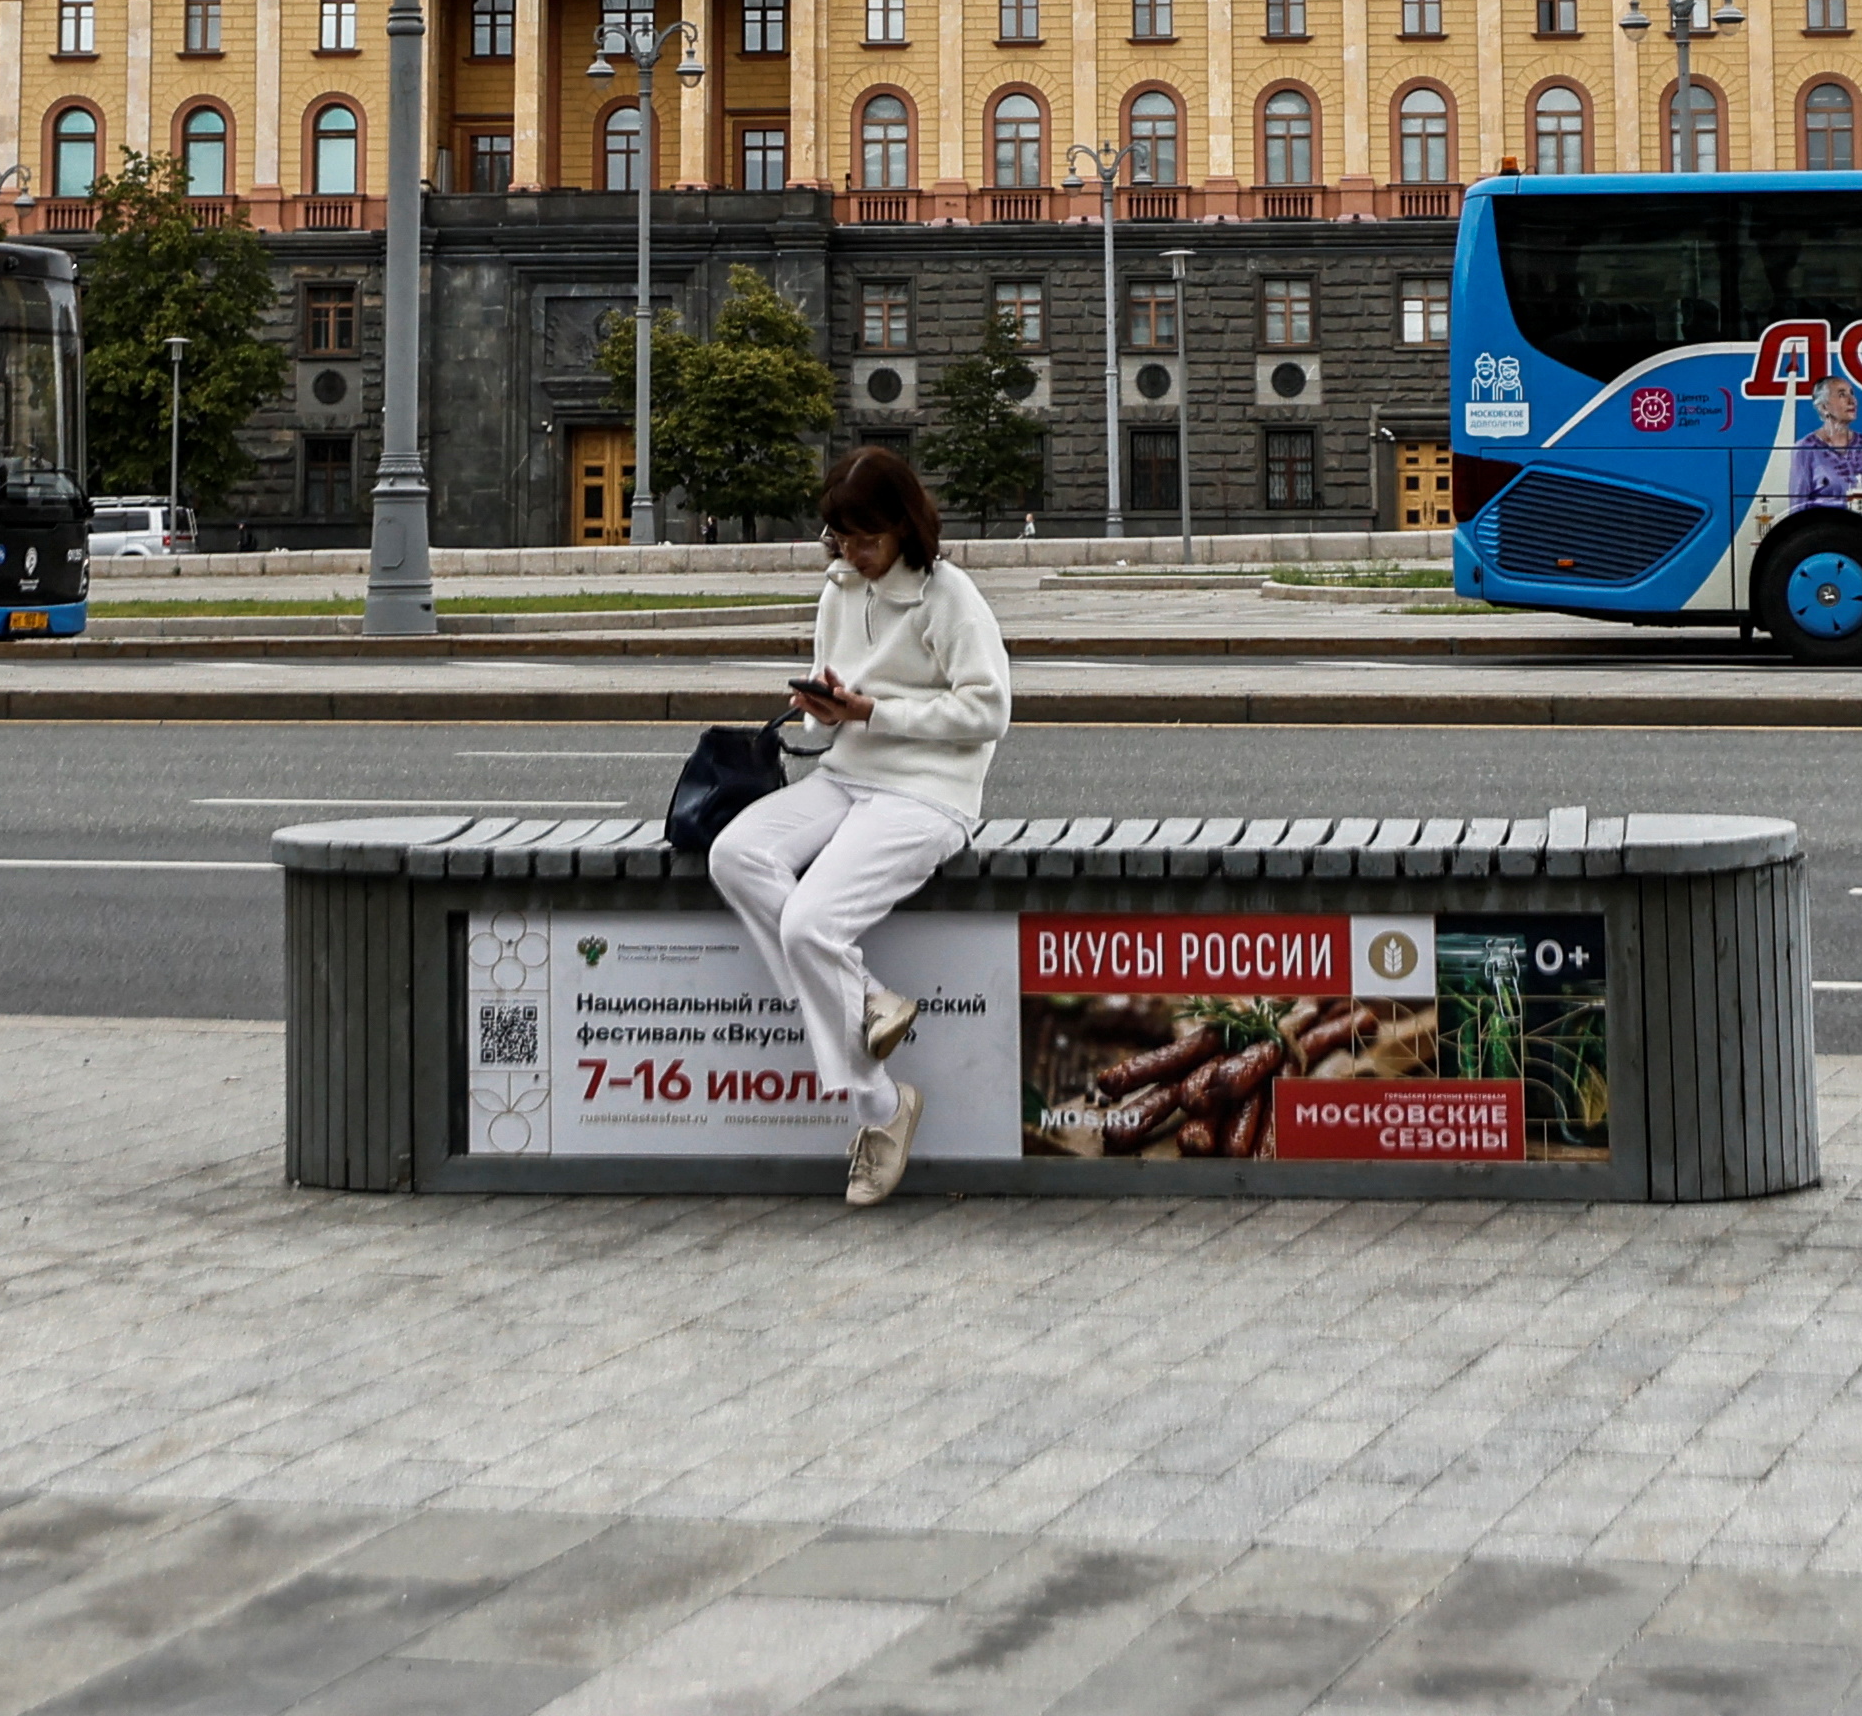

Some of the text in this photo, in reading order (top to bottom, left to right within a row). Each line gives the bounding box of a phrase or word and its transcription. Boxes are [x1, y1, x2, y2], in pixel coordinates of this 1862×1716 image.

[1470, 409, 1524, 419] МОСКОВСКОЕ
[1039, 931, 1332, 979] ВКУСЫ РОССИИ
[1535, 938, 1589, 975] 0+
[577, 993, 752, 1015] Национальный
[577, 1022, 805, 1047] фестиваль «Вкусы
[1040, 1109, 1141, 1128] MOS.RU
[1296, 1103, 1508, 1126] МОСКОВСКИЕ
[1379, 1127, 1508, 1150] СЕЗОНЫ
